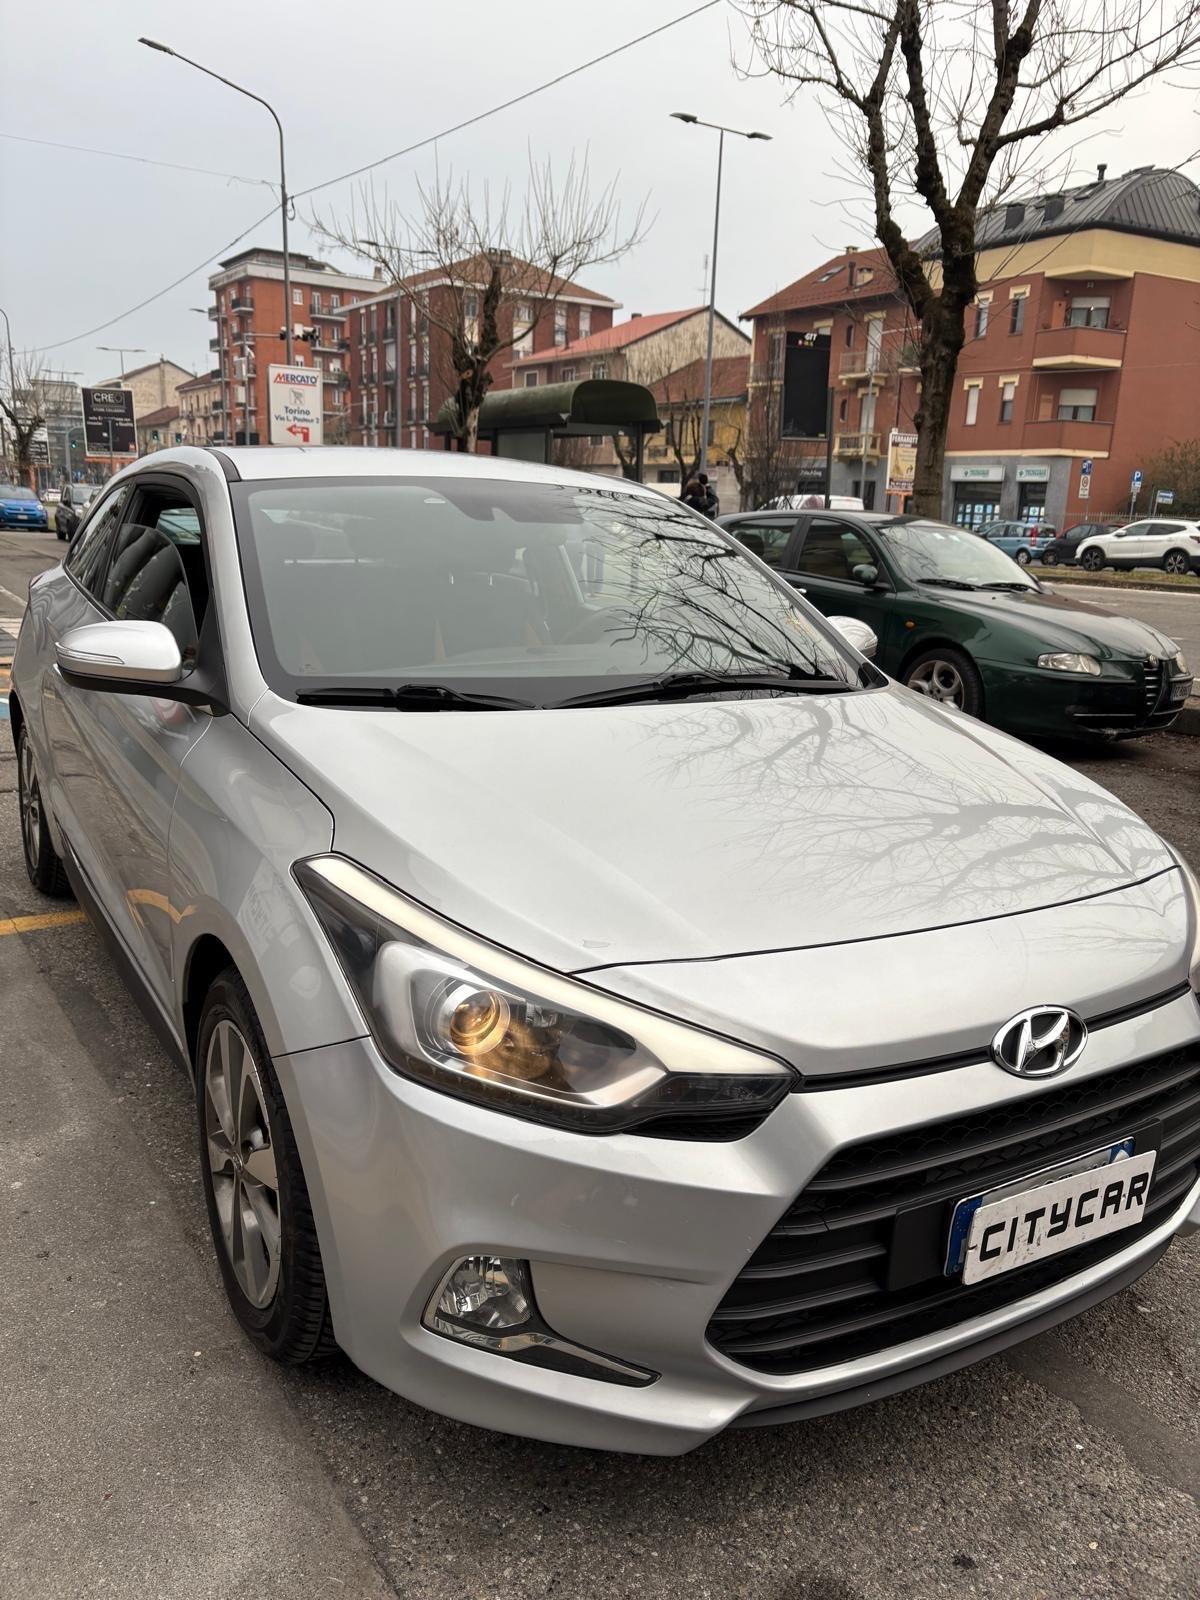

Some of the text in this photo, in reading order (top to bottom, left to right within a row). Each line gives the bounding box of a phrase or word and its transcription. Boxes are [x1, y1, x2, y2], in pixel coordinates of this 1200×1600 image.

[284, 405, 311, 415] Torino
[1134, 471, 1141, 481] P
[979, 1172, 1149, 1262] CITYCAR
